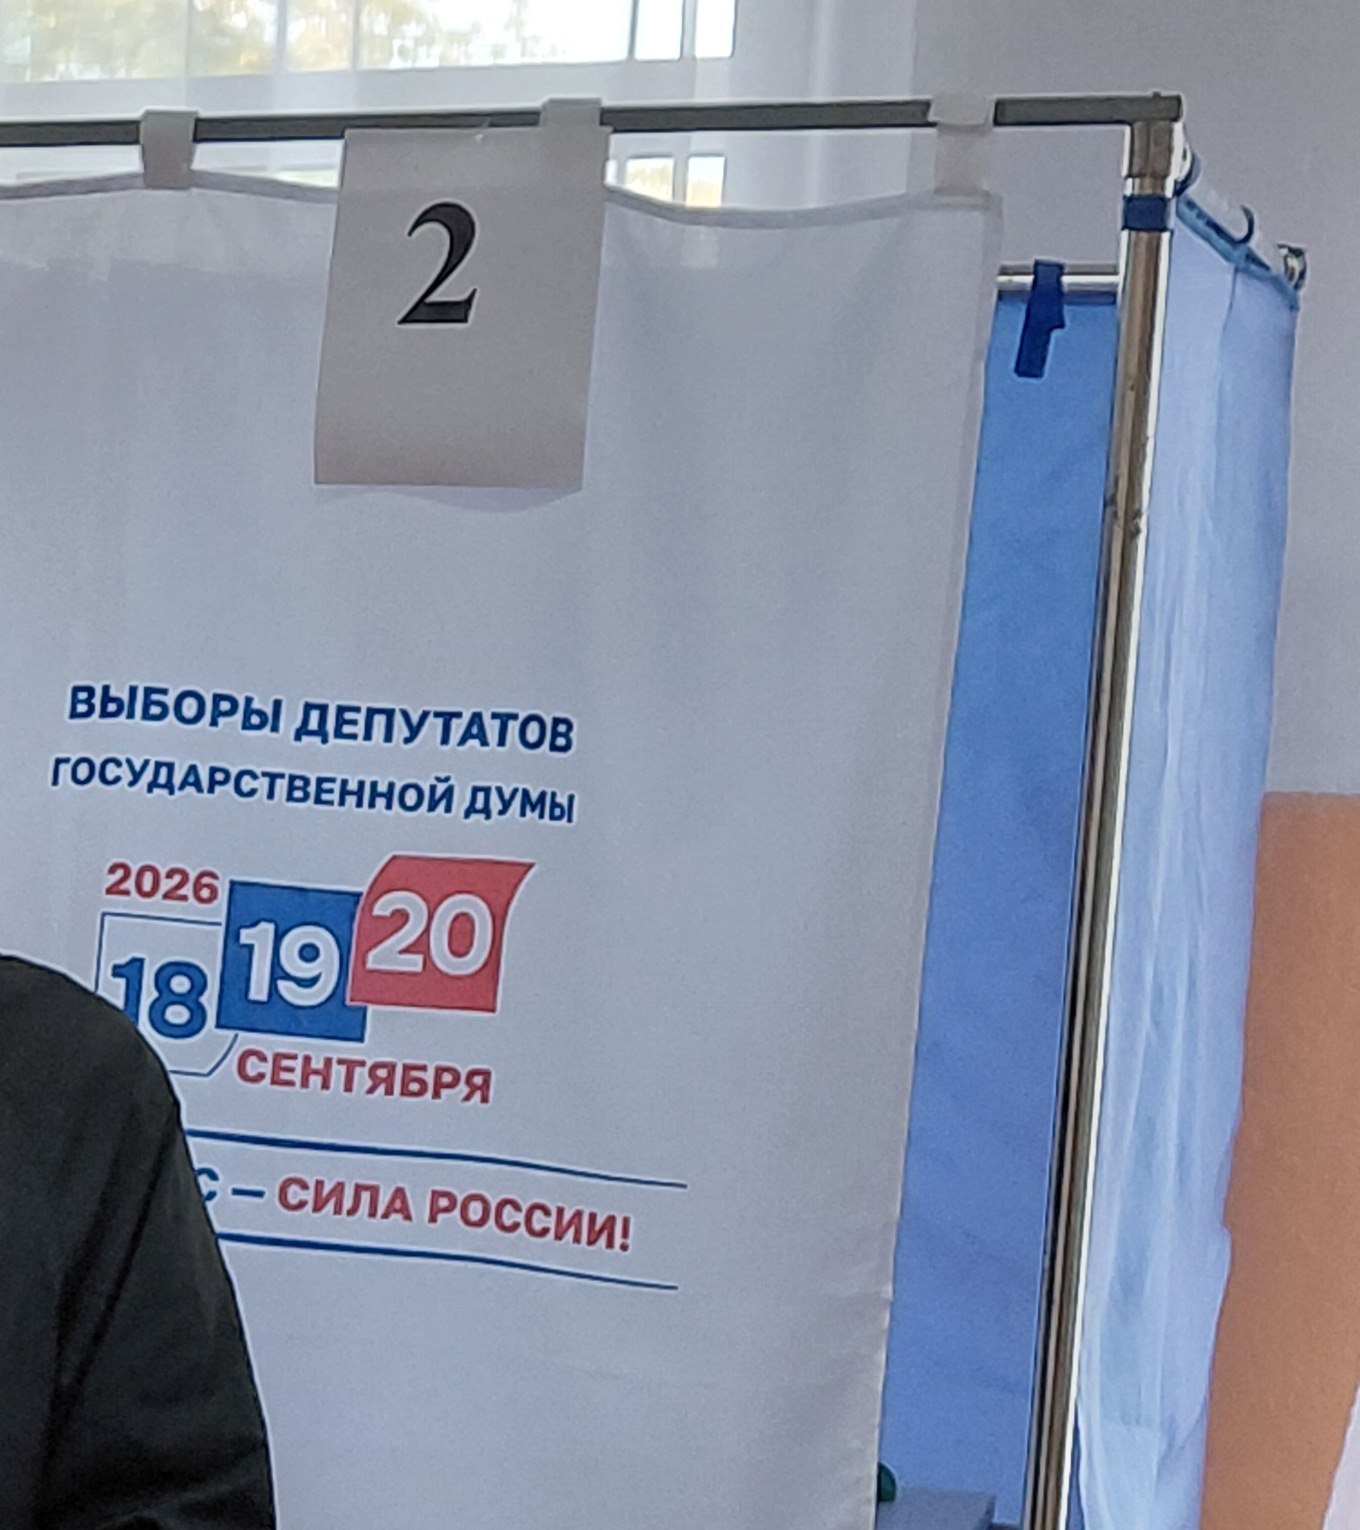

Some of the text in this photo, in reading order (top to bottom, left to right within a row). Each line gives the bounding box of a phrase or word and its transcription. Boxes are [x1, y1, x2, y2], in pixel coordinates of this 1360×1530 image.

[396, 201, 478, 326] 2
[68, 683, 574, 753] ВЫБОРЫ ДЕПУТАТОВ
[51, 756, 576, 824] ГОСУДАРСТВЕННОЙ ДУМЫ
[105, 861, 220, 905] 2026
[111, 890, 494, 1040] 18 19 20
[236, 1047, 493, 1104] СЕНТЯБРЯ
[277, 1176, 413, 1222] СИЛА
[427, 1189, 631, 1253] РОССИИ!
